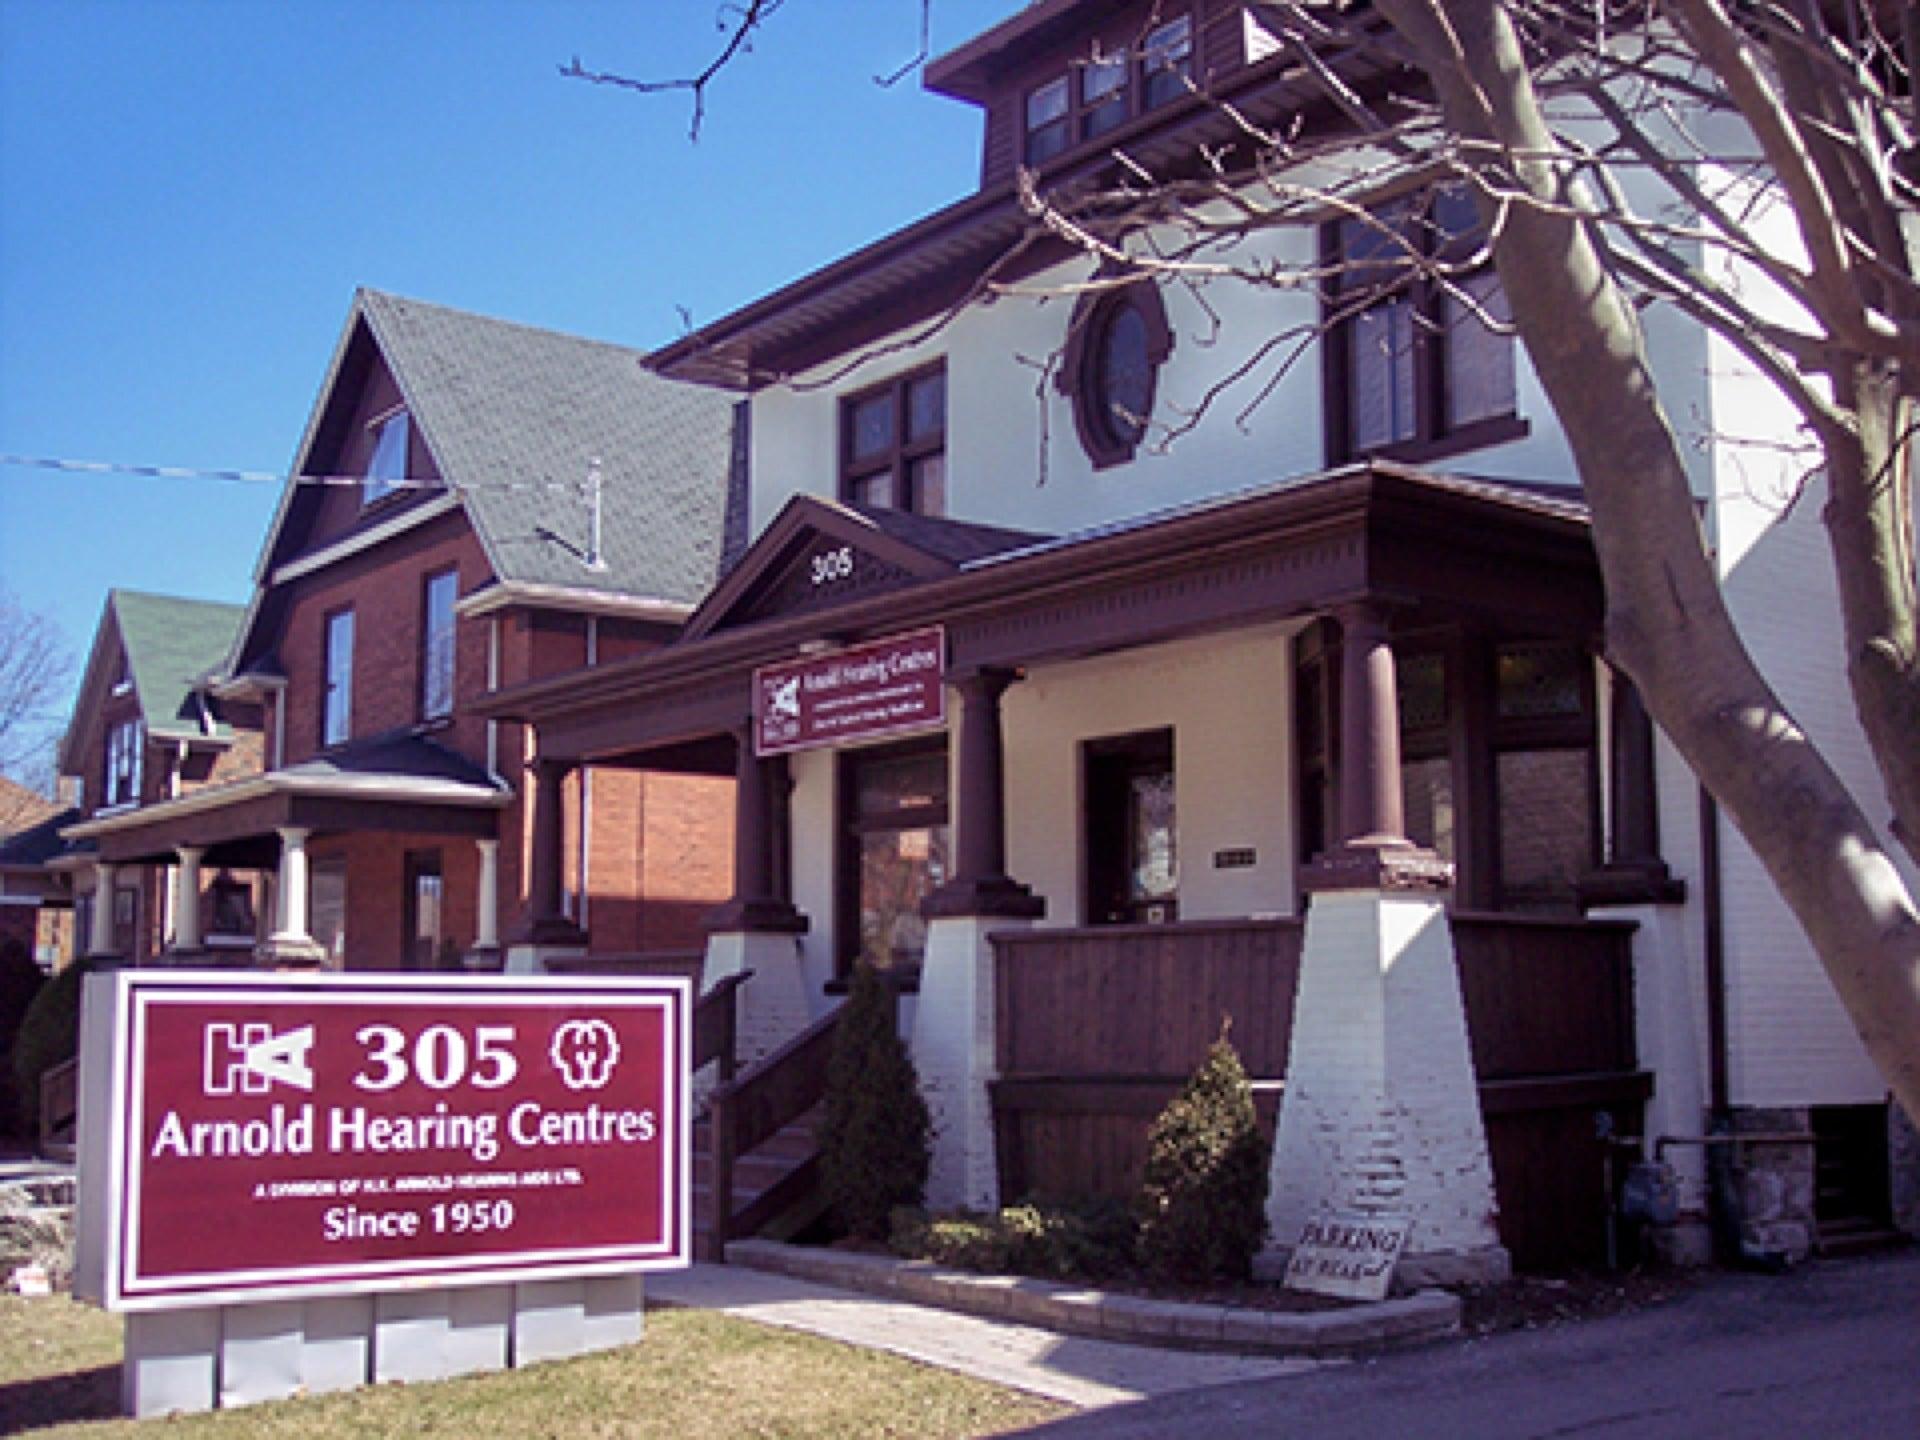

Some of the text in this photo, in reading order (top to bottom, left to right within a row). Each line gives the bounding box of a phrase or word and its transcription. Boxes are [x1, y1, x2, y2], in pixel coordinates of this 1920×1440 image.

[811, 547, 852, 585] 305
[353, 1024, 518, 1089] 305
[151, 1100, 656, 1161] Arnold Hearing Centres
[339, 1179, 360, 1196] OF
[323, 1199, 515, 1241] Since 1950
